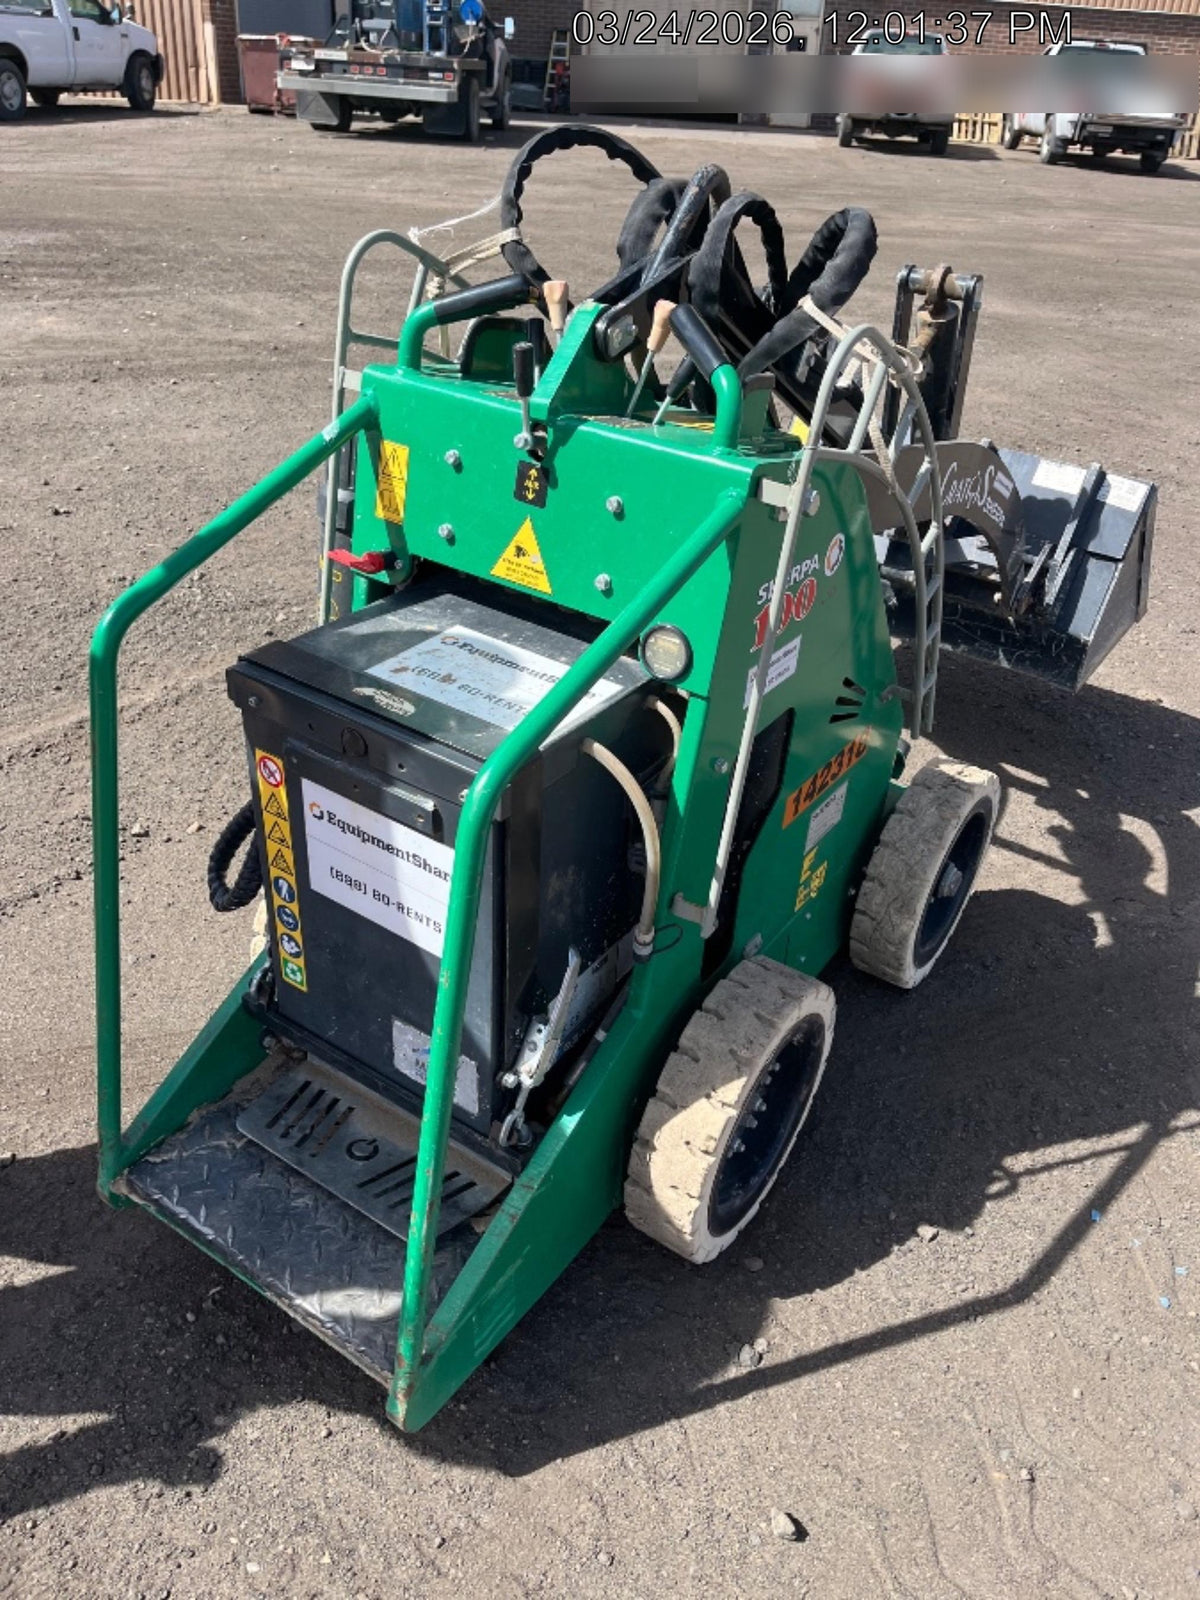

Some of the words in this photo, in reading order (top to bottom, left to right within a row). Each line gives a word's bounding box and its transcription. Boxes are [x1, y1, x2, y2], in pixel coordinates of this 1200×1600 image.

[757, 554, 820, 605] SRPA
[326, 810, 451, 882] EquipmentShar
[373, 888, 442, 934] 80-RENTS
